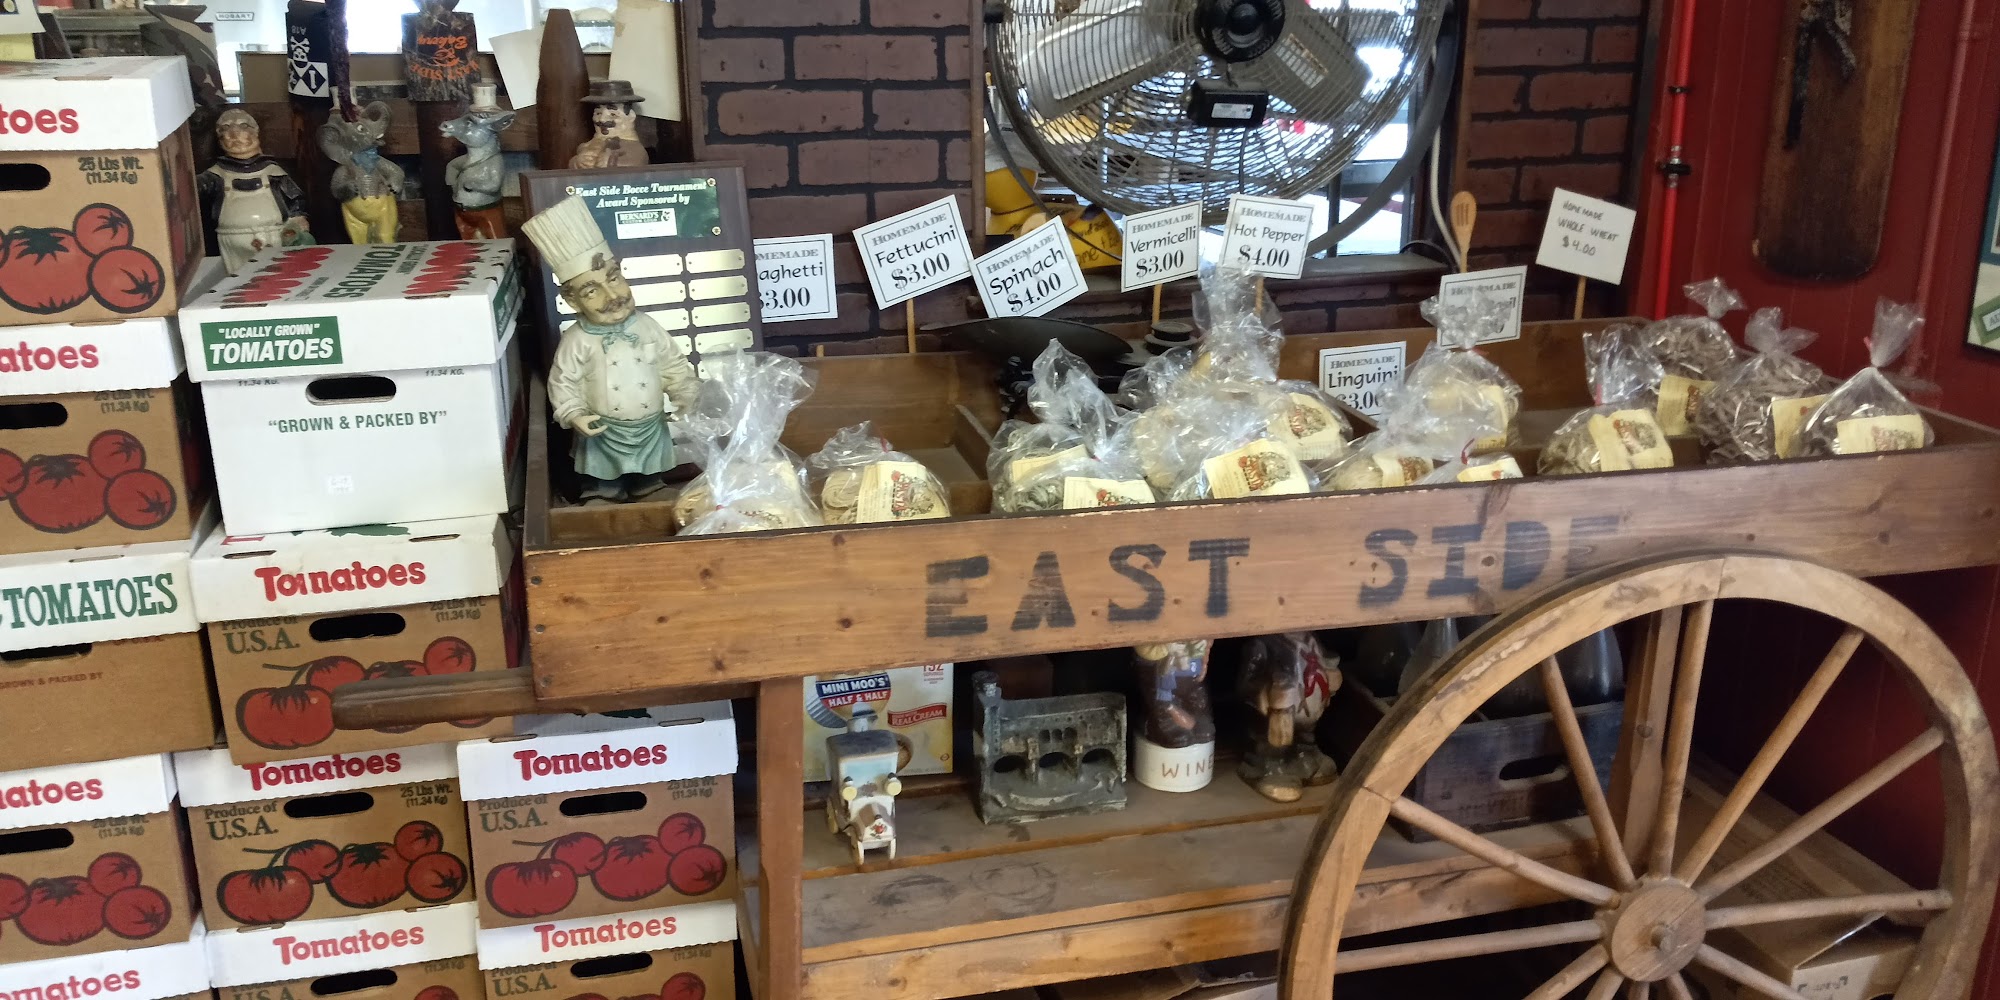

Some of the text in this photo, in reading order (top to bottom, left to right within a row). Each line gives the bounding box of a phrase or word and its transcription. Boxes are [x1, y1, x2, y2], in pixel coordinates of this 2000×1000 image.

[78, 156, 144, 171] 25 Lbs Wt.
[86, 172, 138, 184] (11.34 Kg)
[576, 181, 706, 198] East Side Bocce Tournament
[596, 194, 690, 208] Award Sponsored by
[1132, 212, 1195, 234] HOMEMADE
[1240, 208, 1306, 222] HOMEMADE
[872, 213, 947, 246] HOMEMADE
[1130, 226, 1196, 254] Vermicelli
[1234, 224, 1305, 244] Hot Pepper
[1558, 218, 1619, 242] WHOLE WHEAT
[875, 224, 956, 268] Fettucini
[986, 234, 1054, 274] HOMEMADE
[1238, 244, 1290, 268] $4.00
[323, 244, 406, 298] TOMATOES
[891, 252, 950, 292] $3.00
[990, 248, 1064, 295] Spinach
[1136, 250, 1184, 278] $3.00
[1007, 272, 1062, 314] $4.00
[218, 323, 320, 340] "LOCALLY GROWN"
[210, 338, 334, 364] TOMATOES
[1330, 356, 1396, 369] HOMEMADE
[450, 368, 464, 376] KG.
[1328, 365, 1398, 389] Linguini
[102, 400, 132, 413] (11.34
[340, 416, 350, 430] &
[356, 412, 414, 428] PACKED
[254, 561, 426, 602] Tomatoes
[926, 516, 1620, 638] EAST SIDE
[2, 572, 178, 628] TOMATOES
[436, 609, 480, 622] (11.34 Kg)
[223, 628, 300, 654] U.S.A.
[38, 676, 46, 685] &
[48, 674, 86, 684] PACKED
[90, 672, 104, 680] BY
[822, 677, 886, 694] MINI MOO'S
[828, 690, 888, 708] HALF & HALF
[243, 752, 401, 791] Tomatoes
[514, 744, 667, 781] Tomatoes
[401, 785, 414, 798] 25
[416, 785, 434, 796] Lbs
[406, 795, 448, 808] (11.34 Kg)
[672, 789, 698, 800] (11.34
[204, 802, 278, 820] Produce of
[478, 798, 532, 811] Produce
[207, 815, 280, 841] U.S.A.
[480, 807, 548, 832] U.S.A.
[98, 826, 126, 839] (11.34
[272, 926, 424, 965] Tomatoes
[533, 916, 676, 952] Tomatoes
[492, 972, 558, 996] U.S.A.
